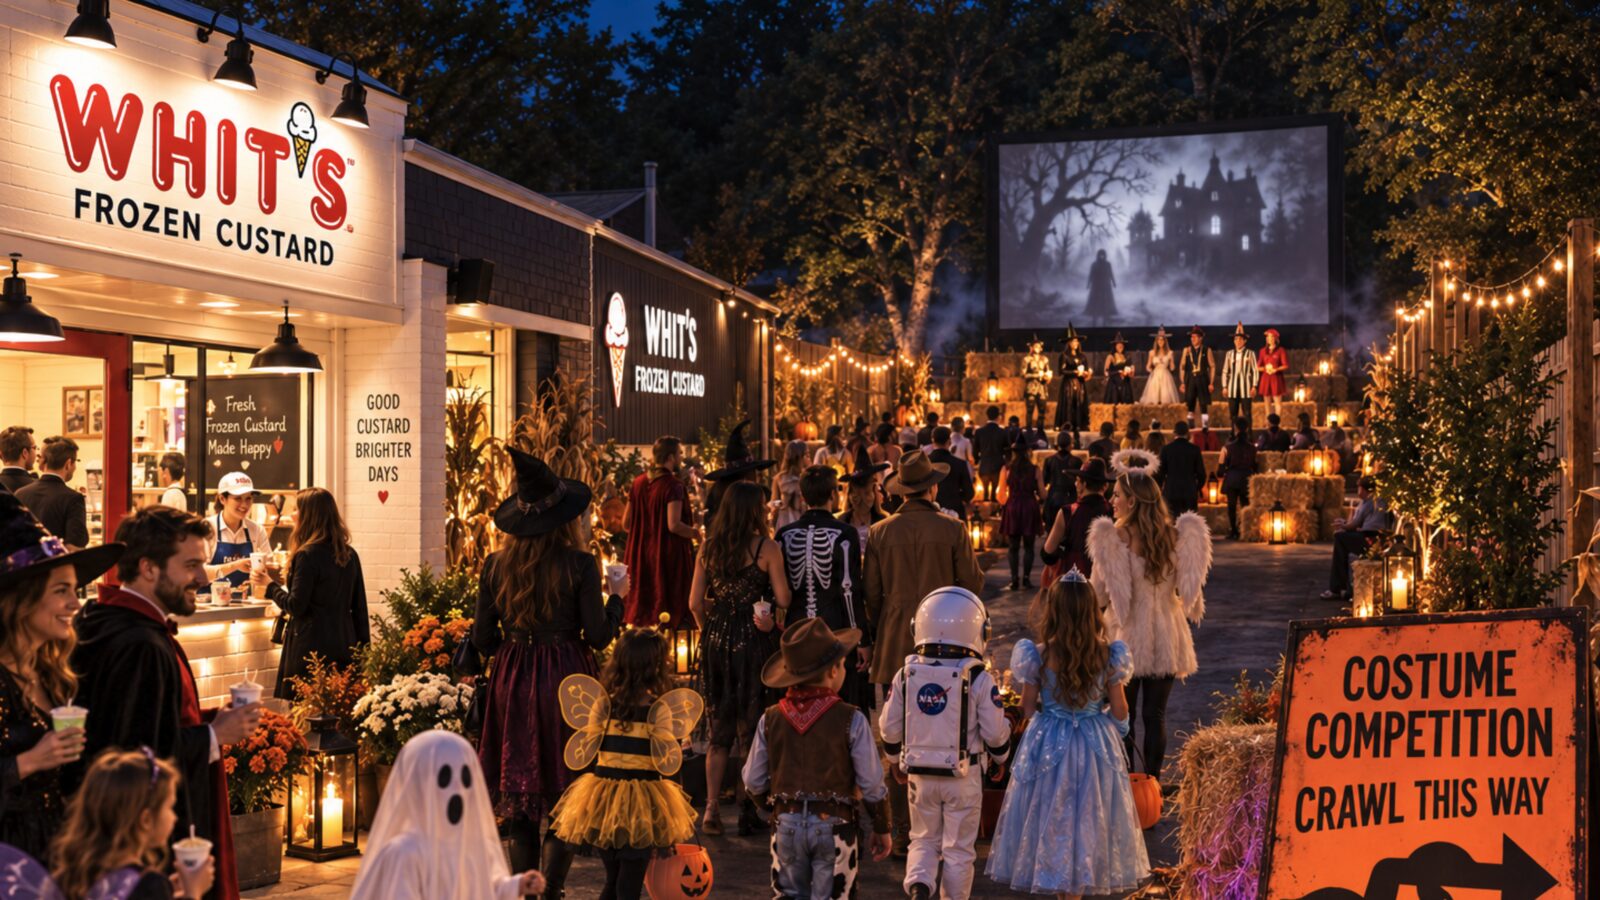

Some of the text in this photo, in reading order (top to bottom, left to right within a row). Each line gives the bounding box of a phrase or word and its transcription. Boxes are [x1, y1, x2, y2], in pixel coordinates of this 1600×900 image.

[50, 74, 347, 230] WHIT'S
[75, 188, 334, 266] FROZEN CUSTARD
[644, 304, 697, 362] WHIT'S
[635, 365, 705, 398] FROZEN CUSTARD
[225, 394, 257, 413] Fresh
[367, 393, 400, 410] GOOD
[205, 415, 287, 434] Frozen Custard
[357, 417, 411, 434] CUSTARD
[208, 438, 272, 460] Made Happy
[356, 442, 412, 458] BRIGHTER
[368, 466, 399, 482] DAYS
[1343, 649, 1517, 702] COSTUME
[1305, 707, 1553, 760] COMPETITION
[1294, 776, 1550, 833] CRAWL THIS WAY
